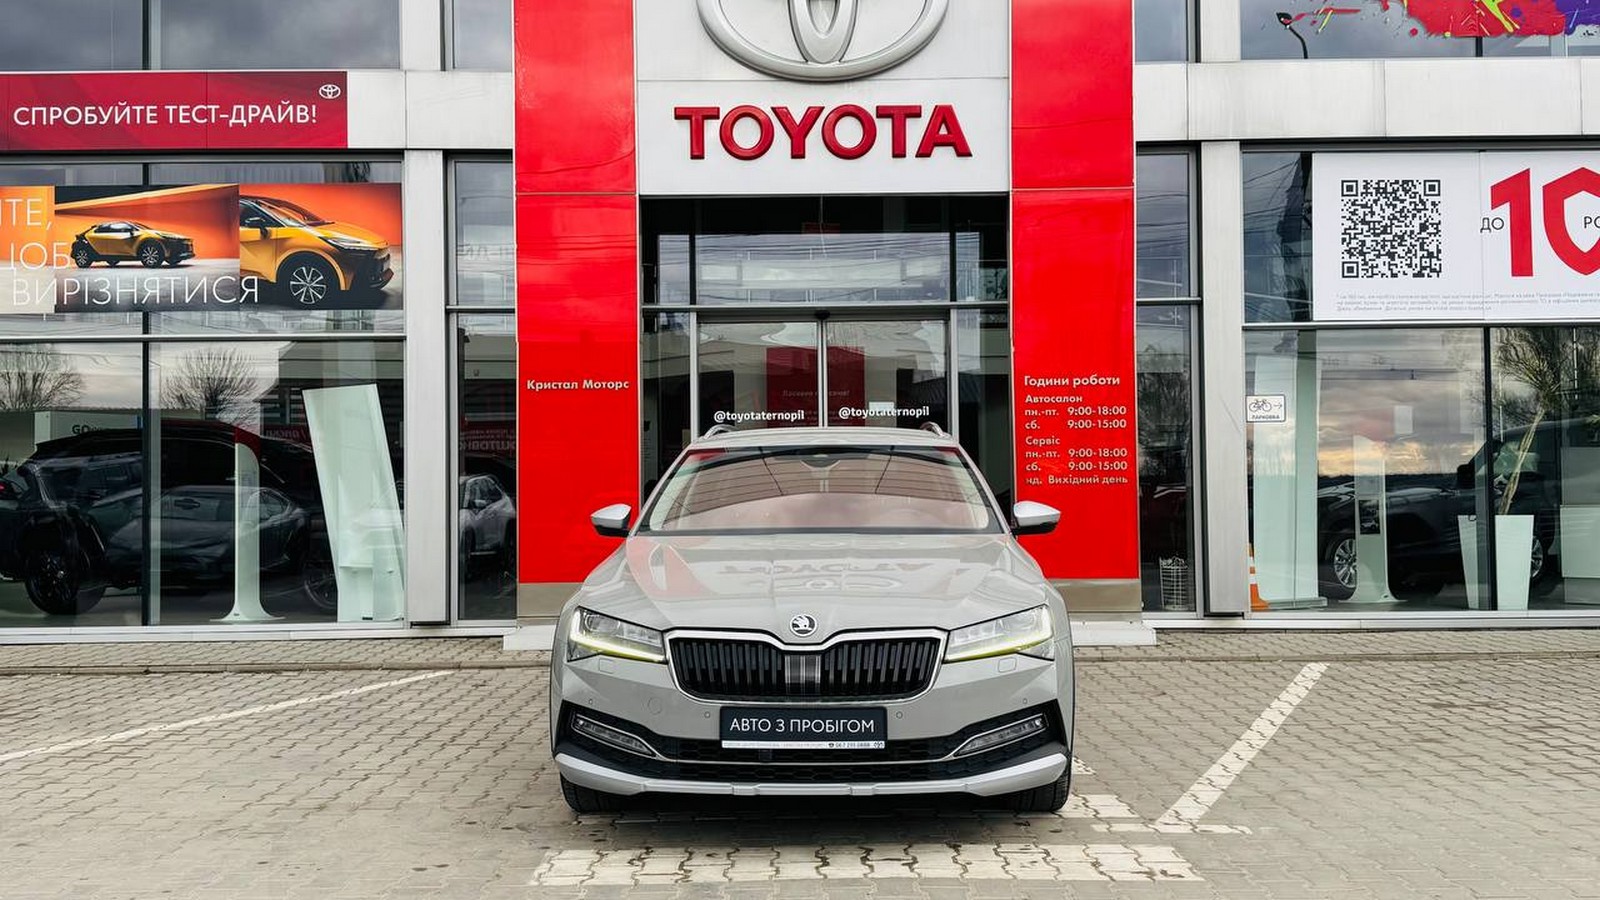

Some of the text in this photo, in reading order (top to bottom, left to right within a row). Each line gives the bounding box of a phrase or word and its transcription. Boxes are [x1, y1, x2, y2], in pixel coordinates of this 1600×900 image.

[13, 100, 317, 127] СПРОБУЙТЕ ТЕСТ-ДРАЙВ!
[674, 104, 972, 160] TOYOTA
[0, 198, 52, 231] ТЕ,
[1480, 216, 1505, 233] ДО
[1490, 167, 1600, 276] 10
[13, 275, 260, 306] ВИРІЗНЯТИСЯ
[526, 379, 630, 391] Кристал Моторс
[1024, 374, 1120, 388] Години роботи
[1025, 394, 1083, 403] Автосалон
[713, 410, 805, 423] @toyotaternopil
[838, 406, 930, 419] @toyotaternopil
[1025, 420, 1041, 429] сб.
[1025, 435, 1061, 446] Сервіс
[1026, 462, 1042, 471] сб.
[1048, 473, 1100, 485] Вихідний
[1102, 476, 1128, 484] день
[730, 718, 875, 733] АВТО З ПРОБІГОМ
